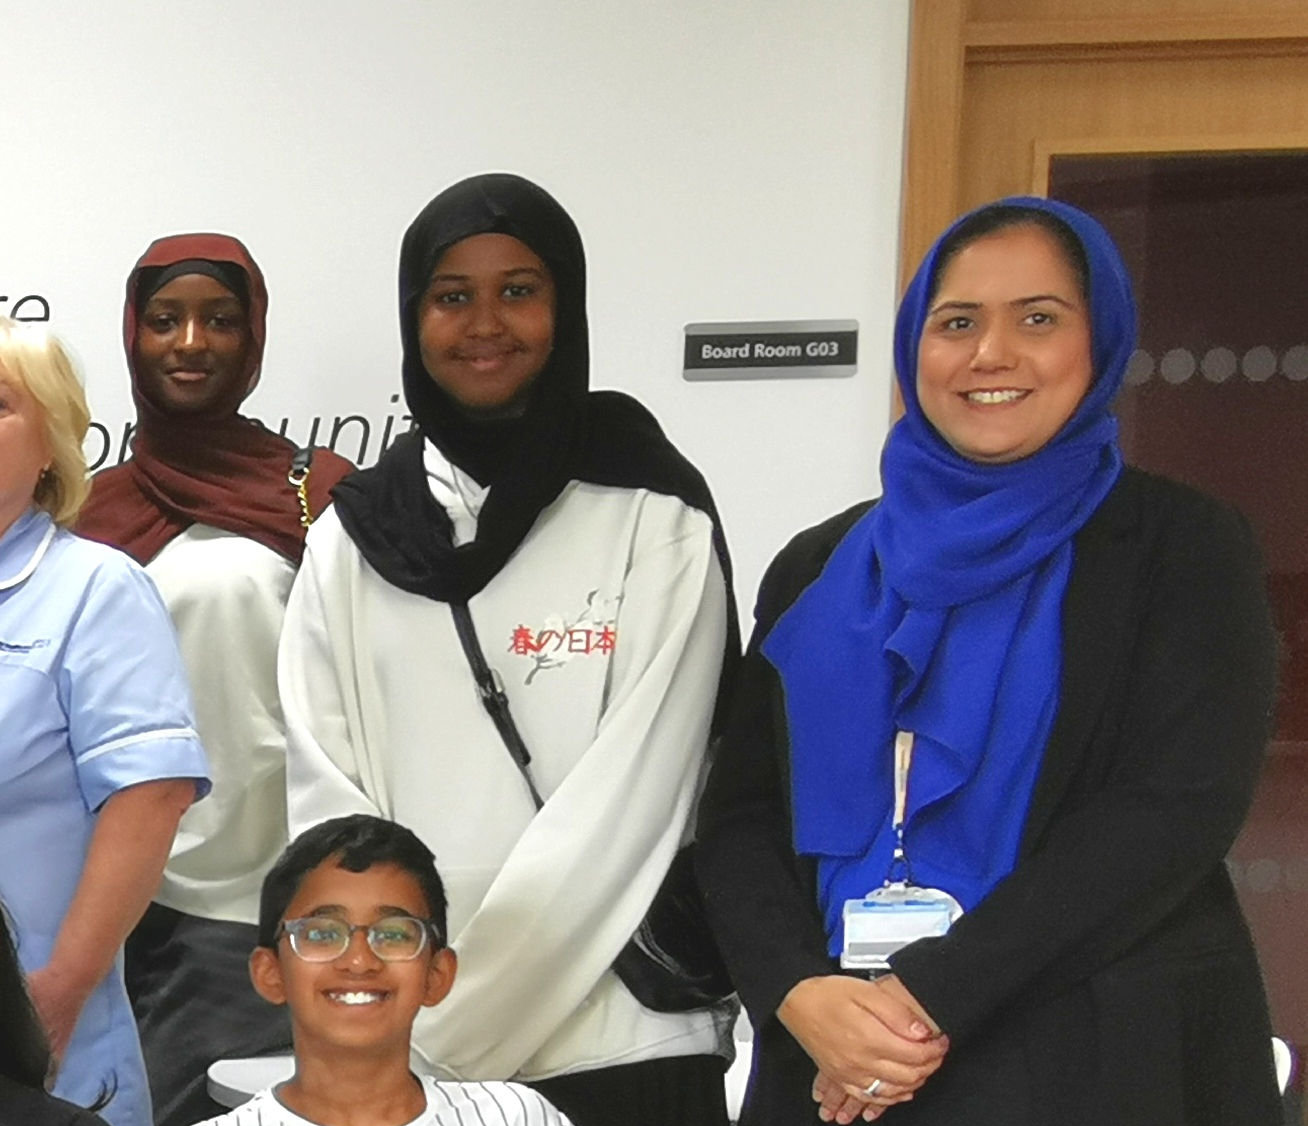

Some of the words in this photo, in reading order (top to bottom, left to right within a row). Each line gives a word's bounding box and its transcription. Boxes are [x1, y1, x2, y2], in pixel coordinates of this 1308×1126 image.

[701, 343, 750, 359] Board
[754, 343, 802, 358] Room
[806, 341, 840, 357] G03
[507, 624, 617, 655] 春の日本
